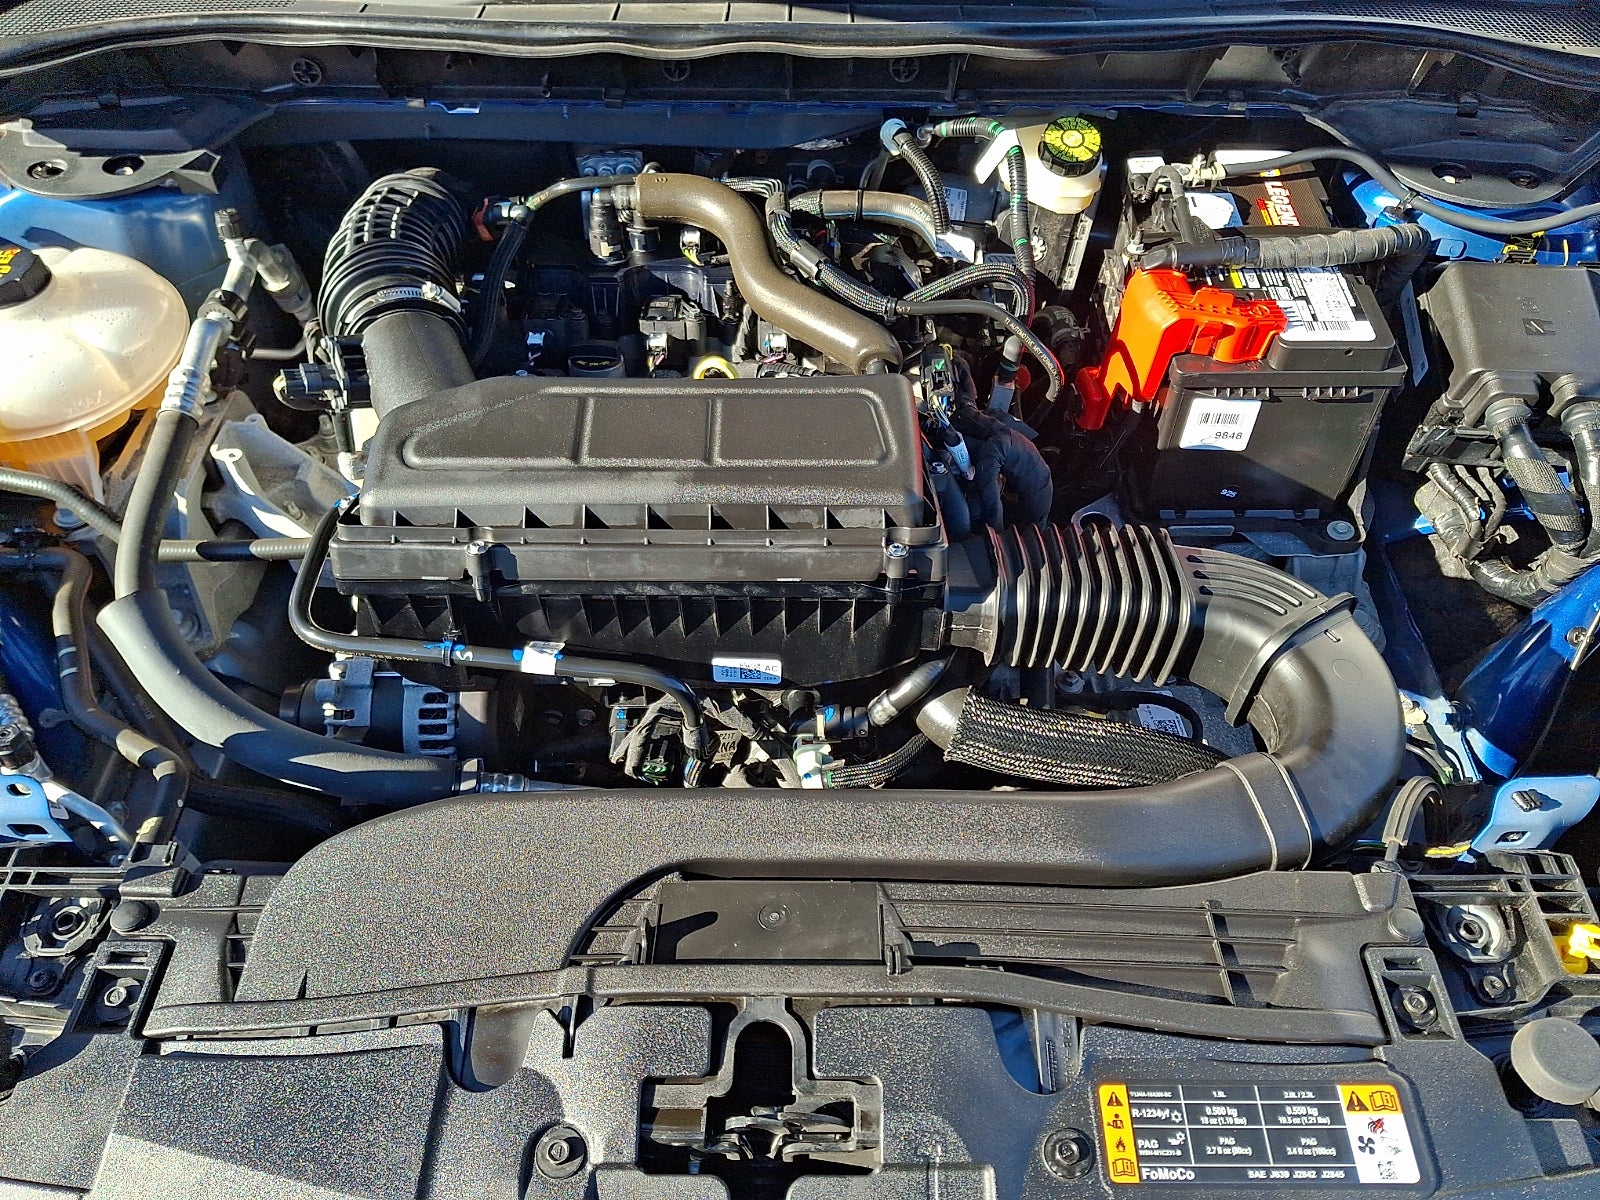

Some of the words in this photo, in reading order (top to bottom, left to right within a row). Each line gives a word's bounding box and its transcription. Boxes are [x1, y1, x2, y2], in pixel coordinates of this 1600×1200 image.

[1131, 1108, 1170, 1120] R-1234yf
[1227, 1106, 1238, 1118] kg
[1307, 1106, 1319, 1117] kg
[1137, 1139, 1160, 1149] PAG
[1219, 1137, 1236, 1146] PAG
[1300, 1137, 1318, 1146] PAG
[1141, 1167, 1196, 1181] FoMoCo
[1248, 1169, 1267, 1179] SAE
